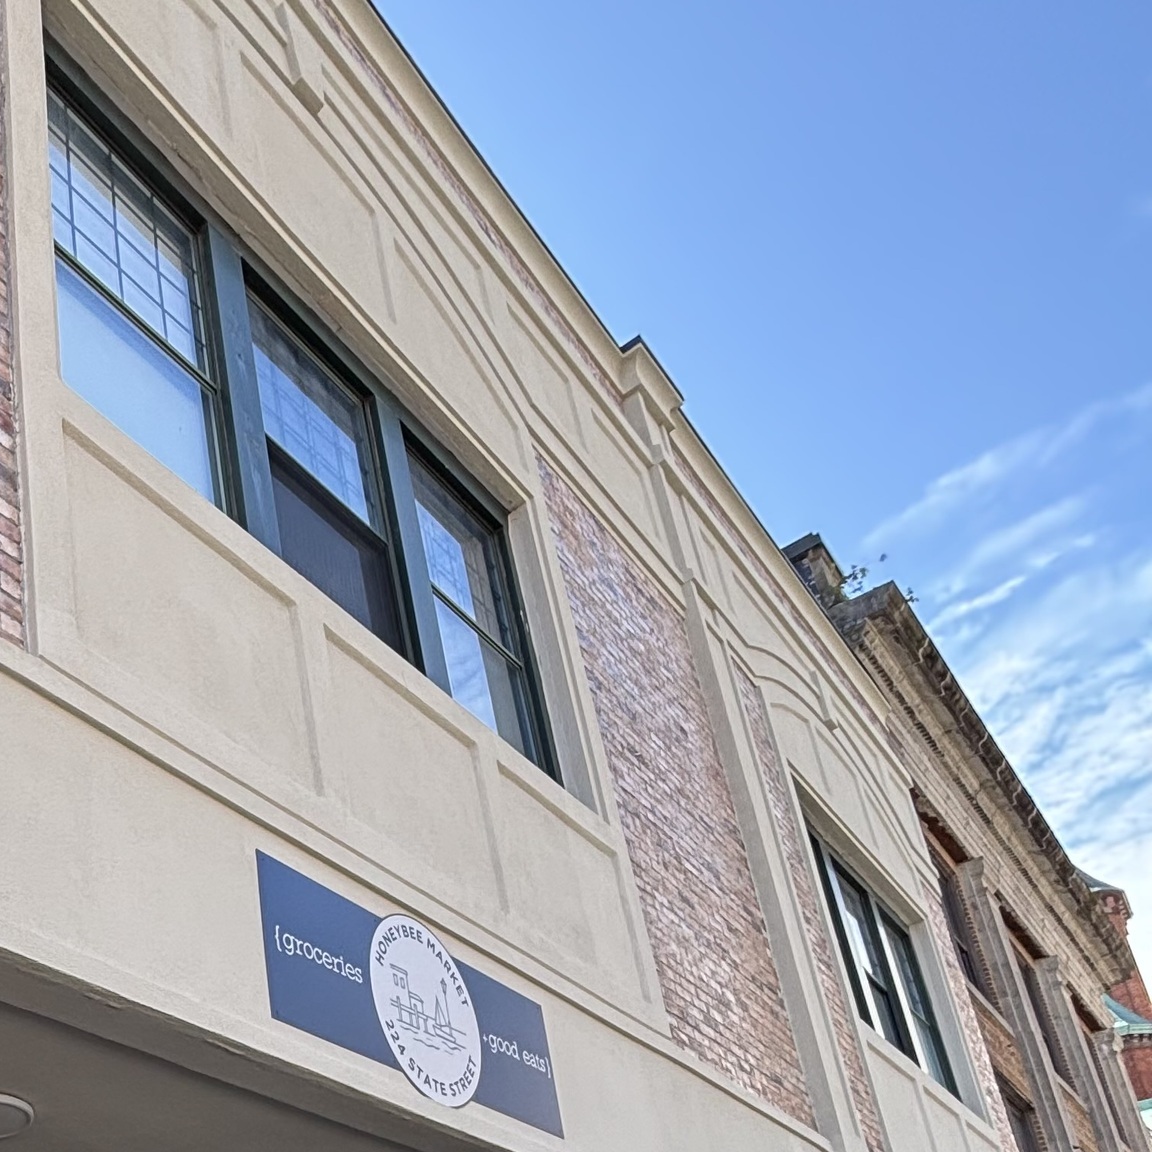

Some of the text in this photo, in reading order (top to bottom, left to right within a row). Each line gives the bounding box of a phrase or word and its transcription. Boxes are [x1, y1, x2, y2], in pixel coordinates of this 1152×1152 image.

[375, 924, 469, 1007] HONEYBEE MARKET
[385, 1019, 477, 1097] 224 STATE STREET
